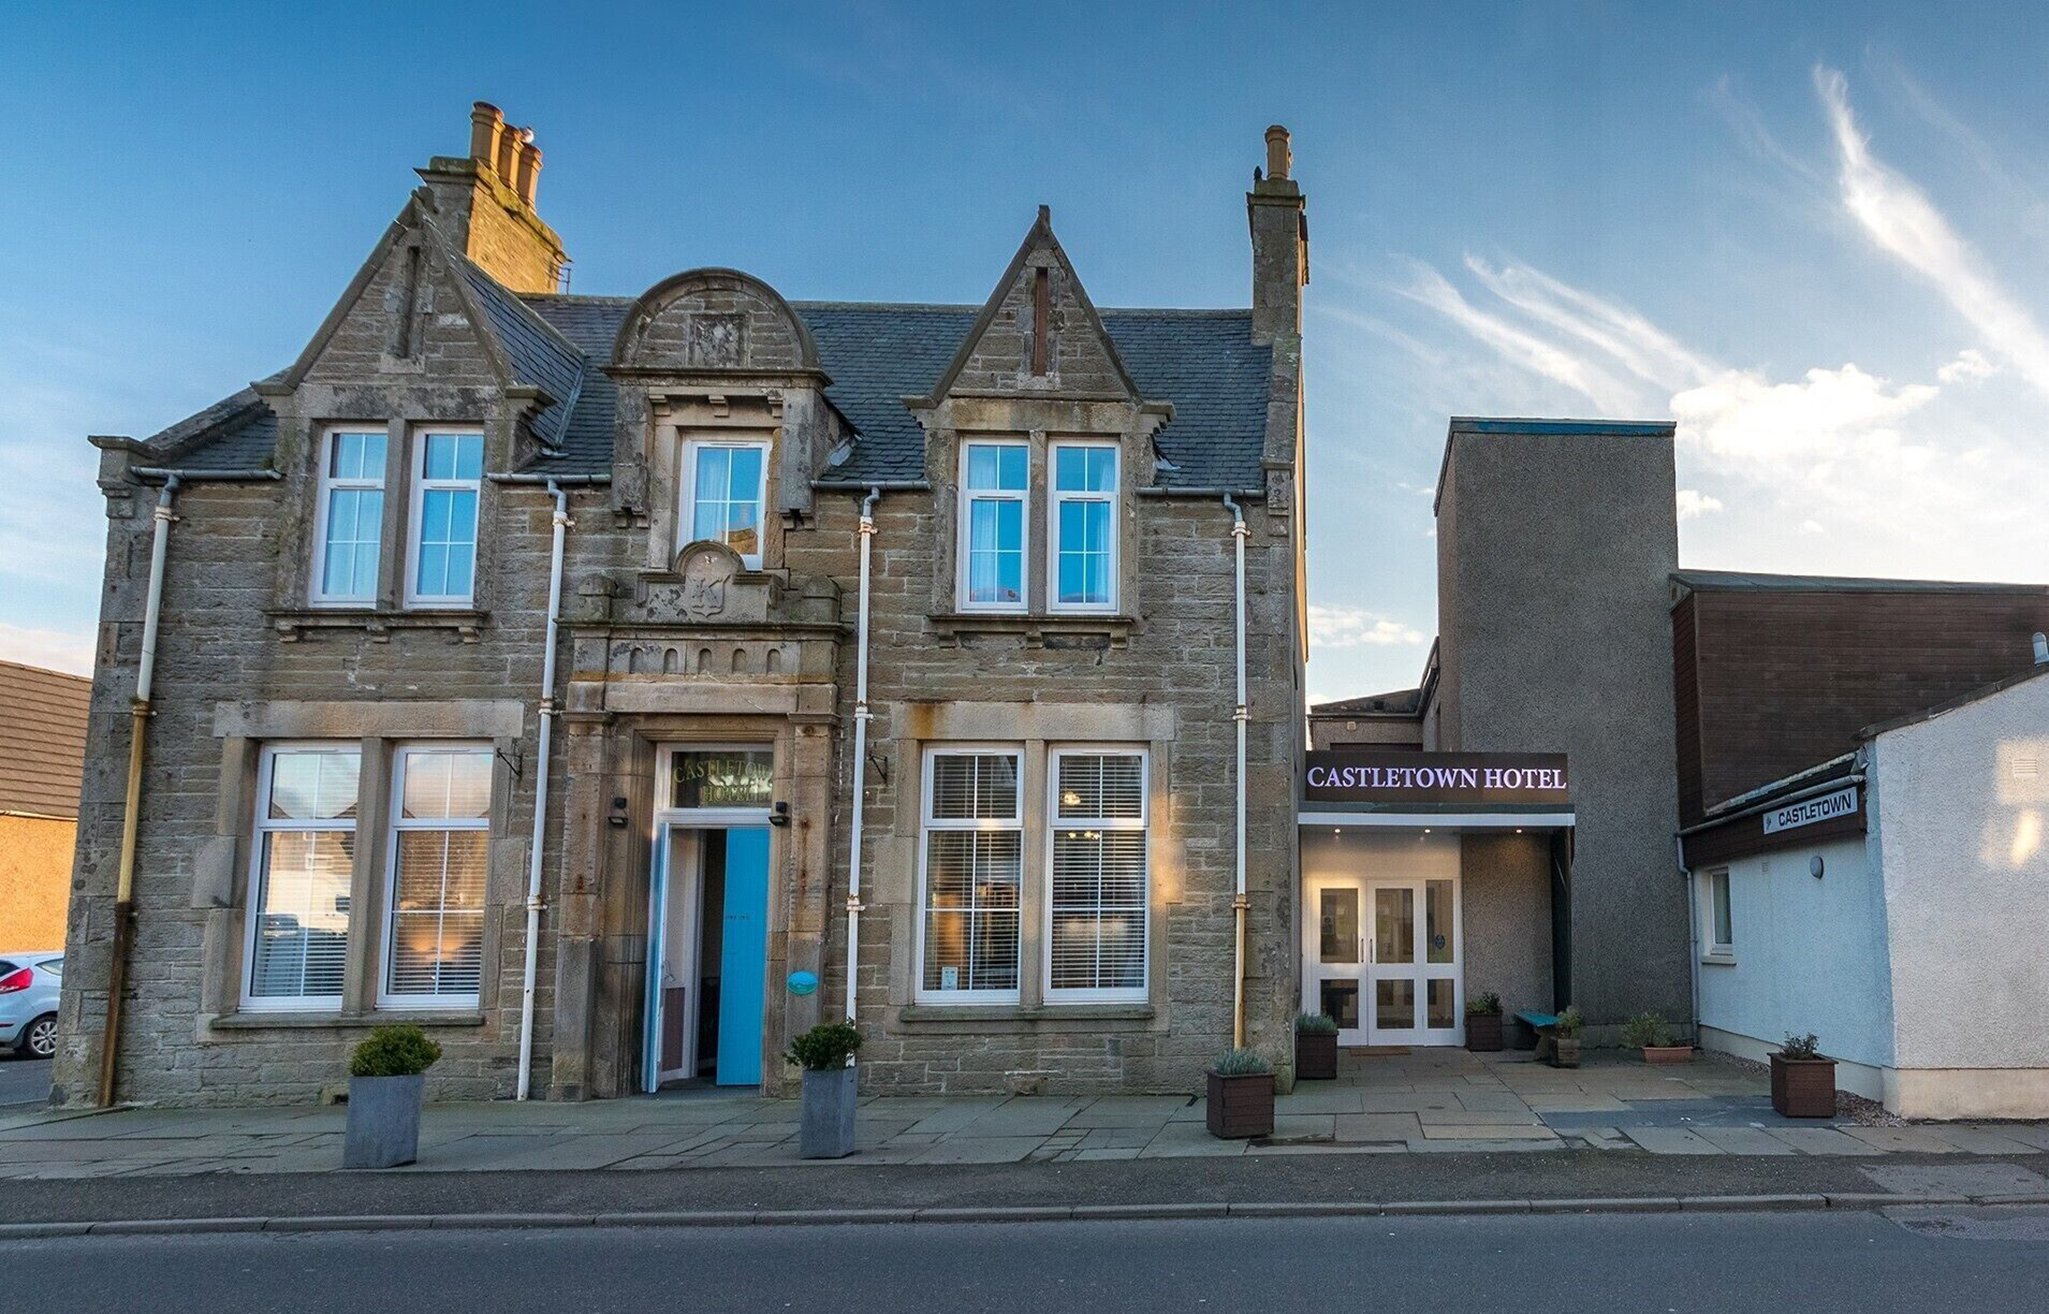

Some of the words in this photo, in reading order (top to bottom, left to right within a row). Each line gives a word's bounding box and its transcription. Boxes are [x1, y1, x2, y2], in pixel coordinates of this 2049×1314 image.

[673, 759, 773, 783] CASTLETOW
[1306, 766, 1477, 789] CASTLETOWN
[1483, 767, 1567, 789] HOTEL
[1778, 792, 1852, 827] CASTLETOWN
